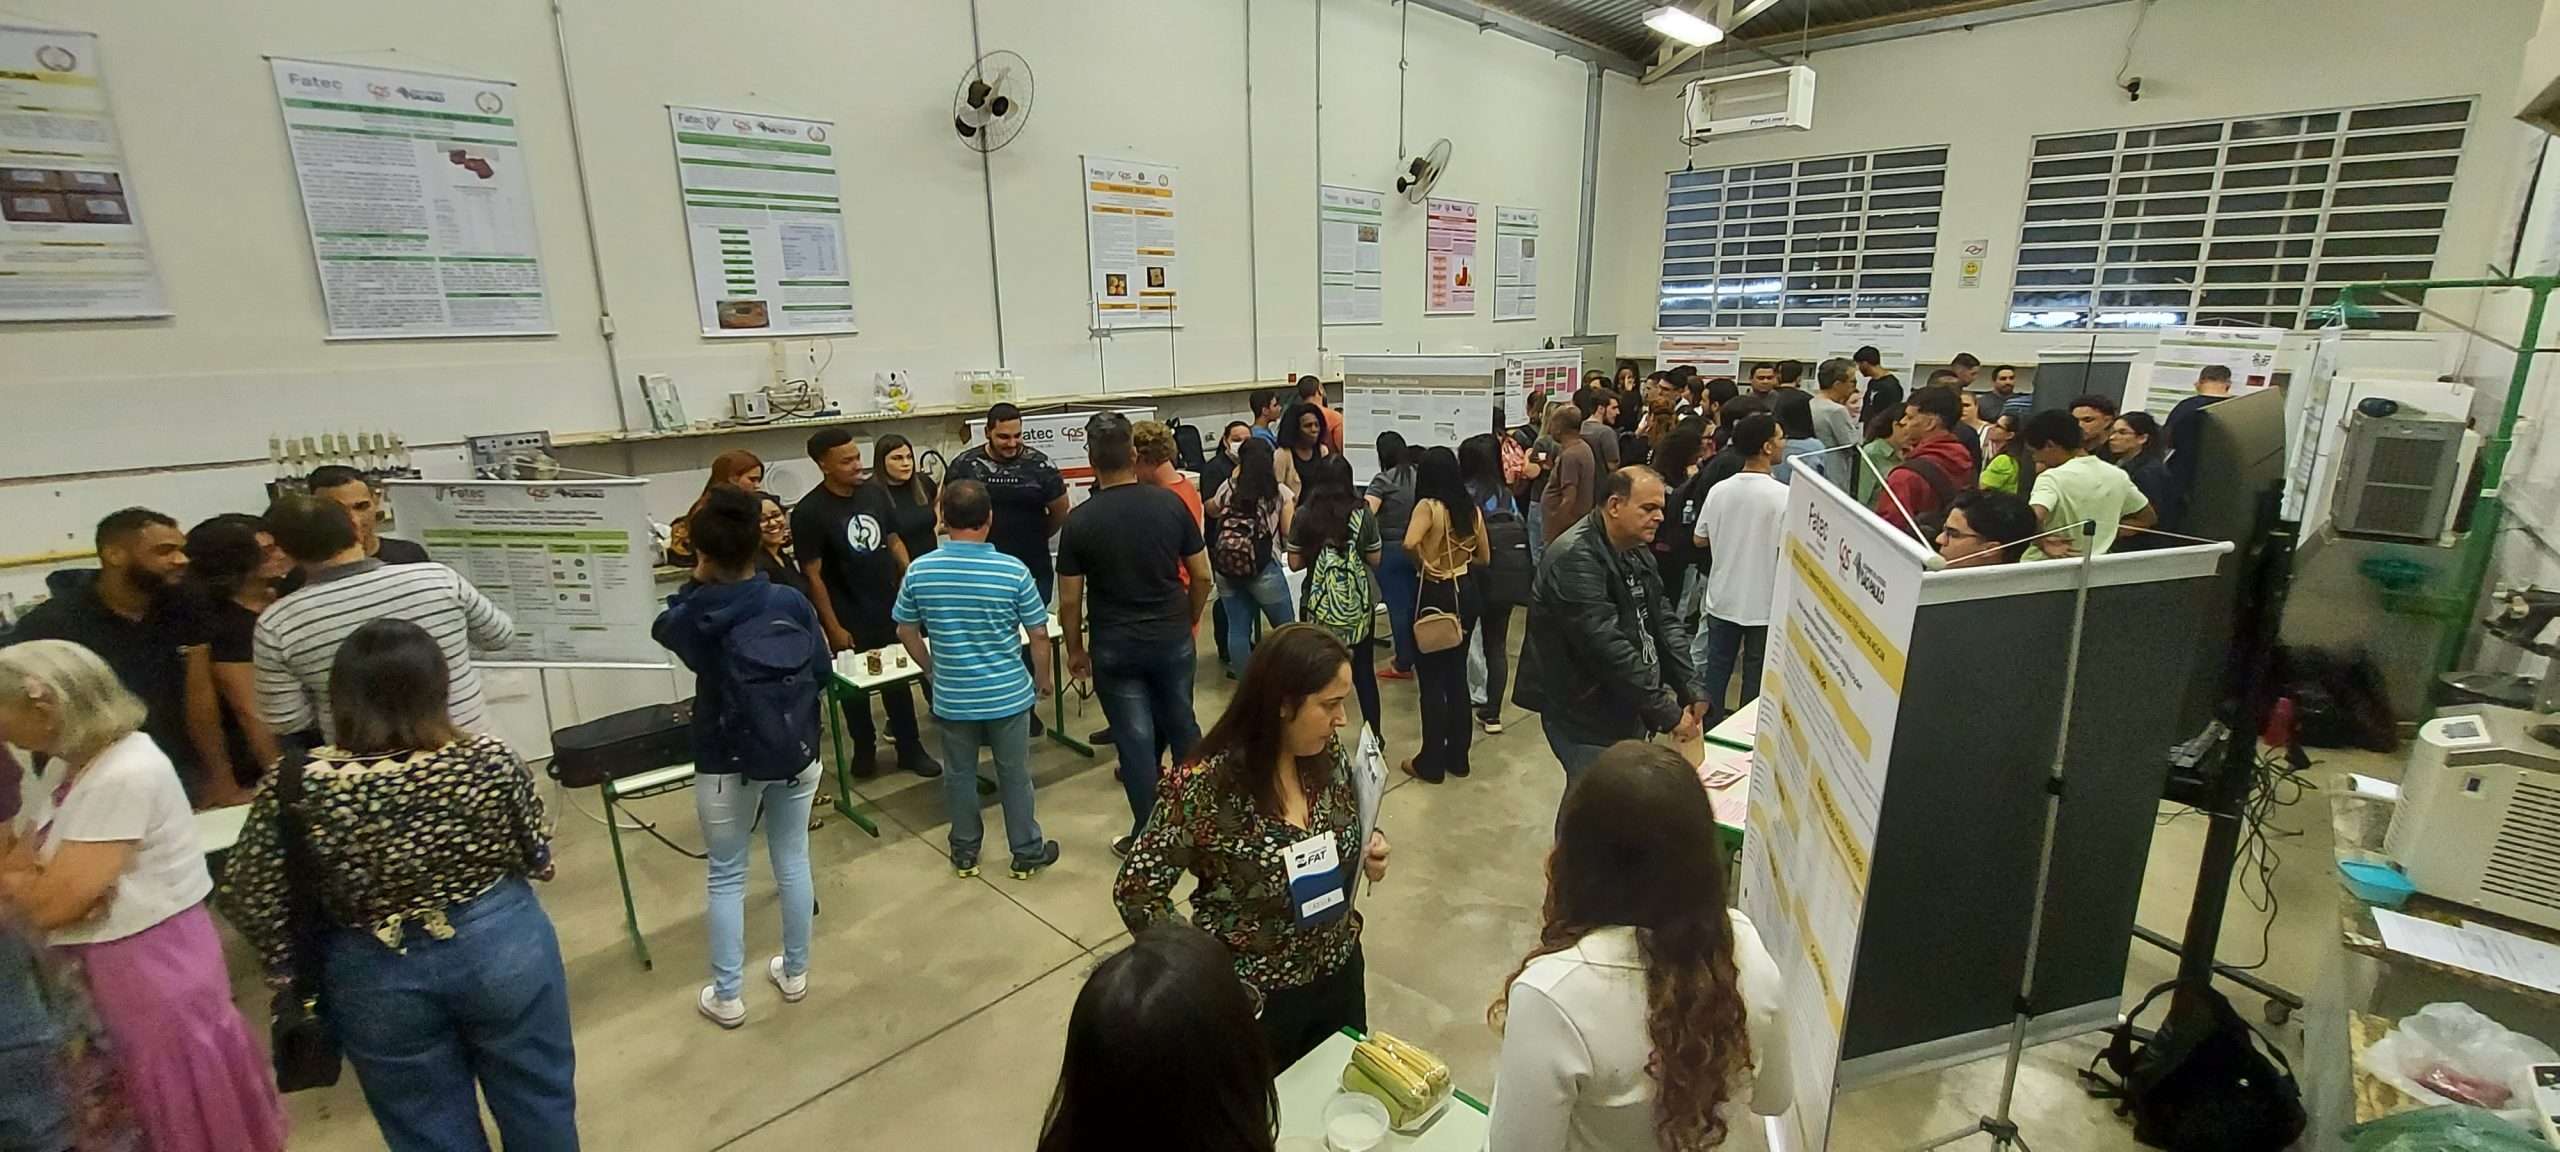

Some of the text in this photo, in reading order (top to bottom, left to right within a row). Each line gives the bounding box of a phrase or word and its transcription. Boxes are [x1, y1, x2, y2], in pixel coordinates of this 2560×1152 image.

[288, 73, 343, 90] Fatec
[1022, 428, 1054, 441] atec
[450, 487, 485, 498] Fatec
[1808, 501, 1829, 542] Fatec
[1307, 849, 1328, 866] FAT
